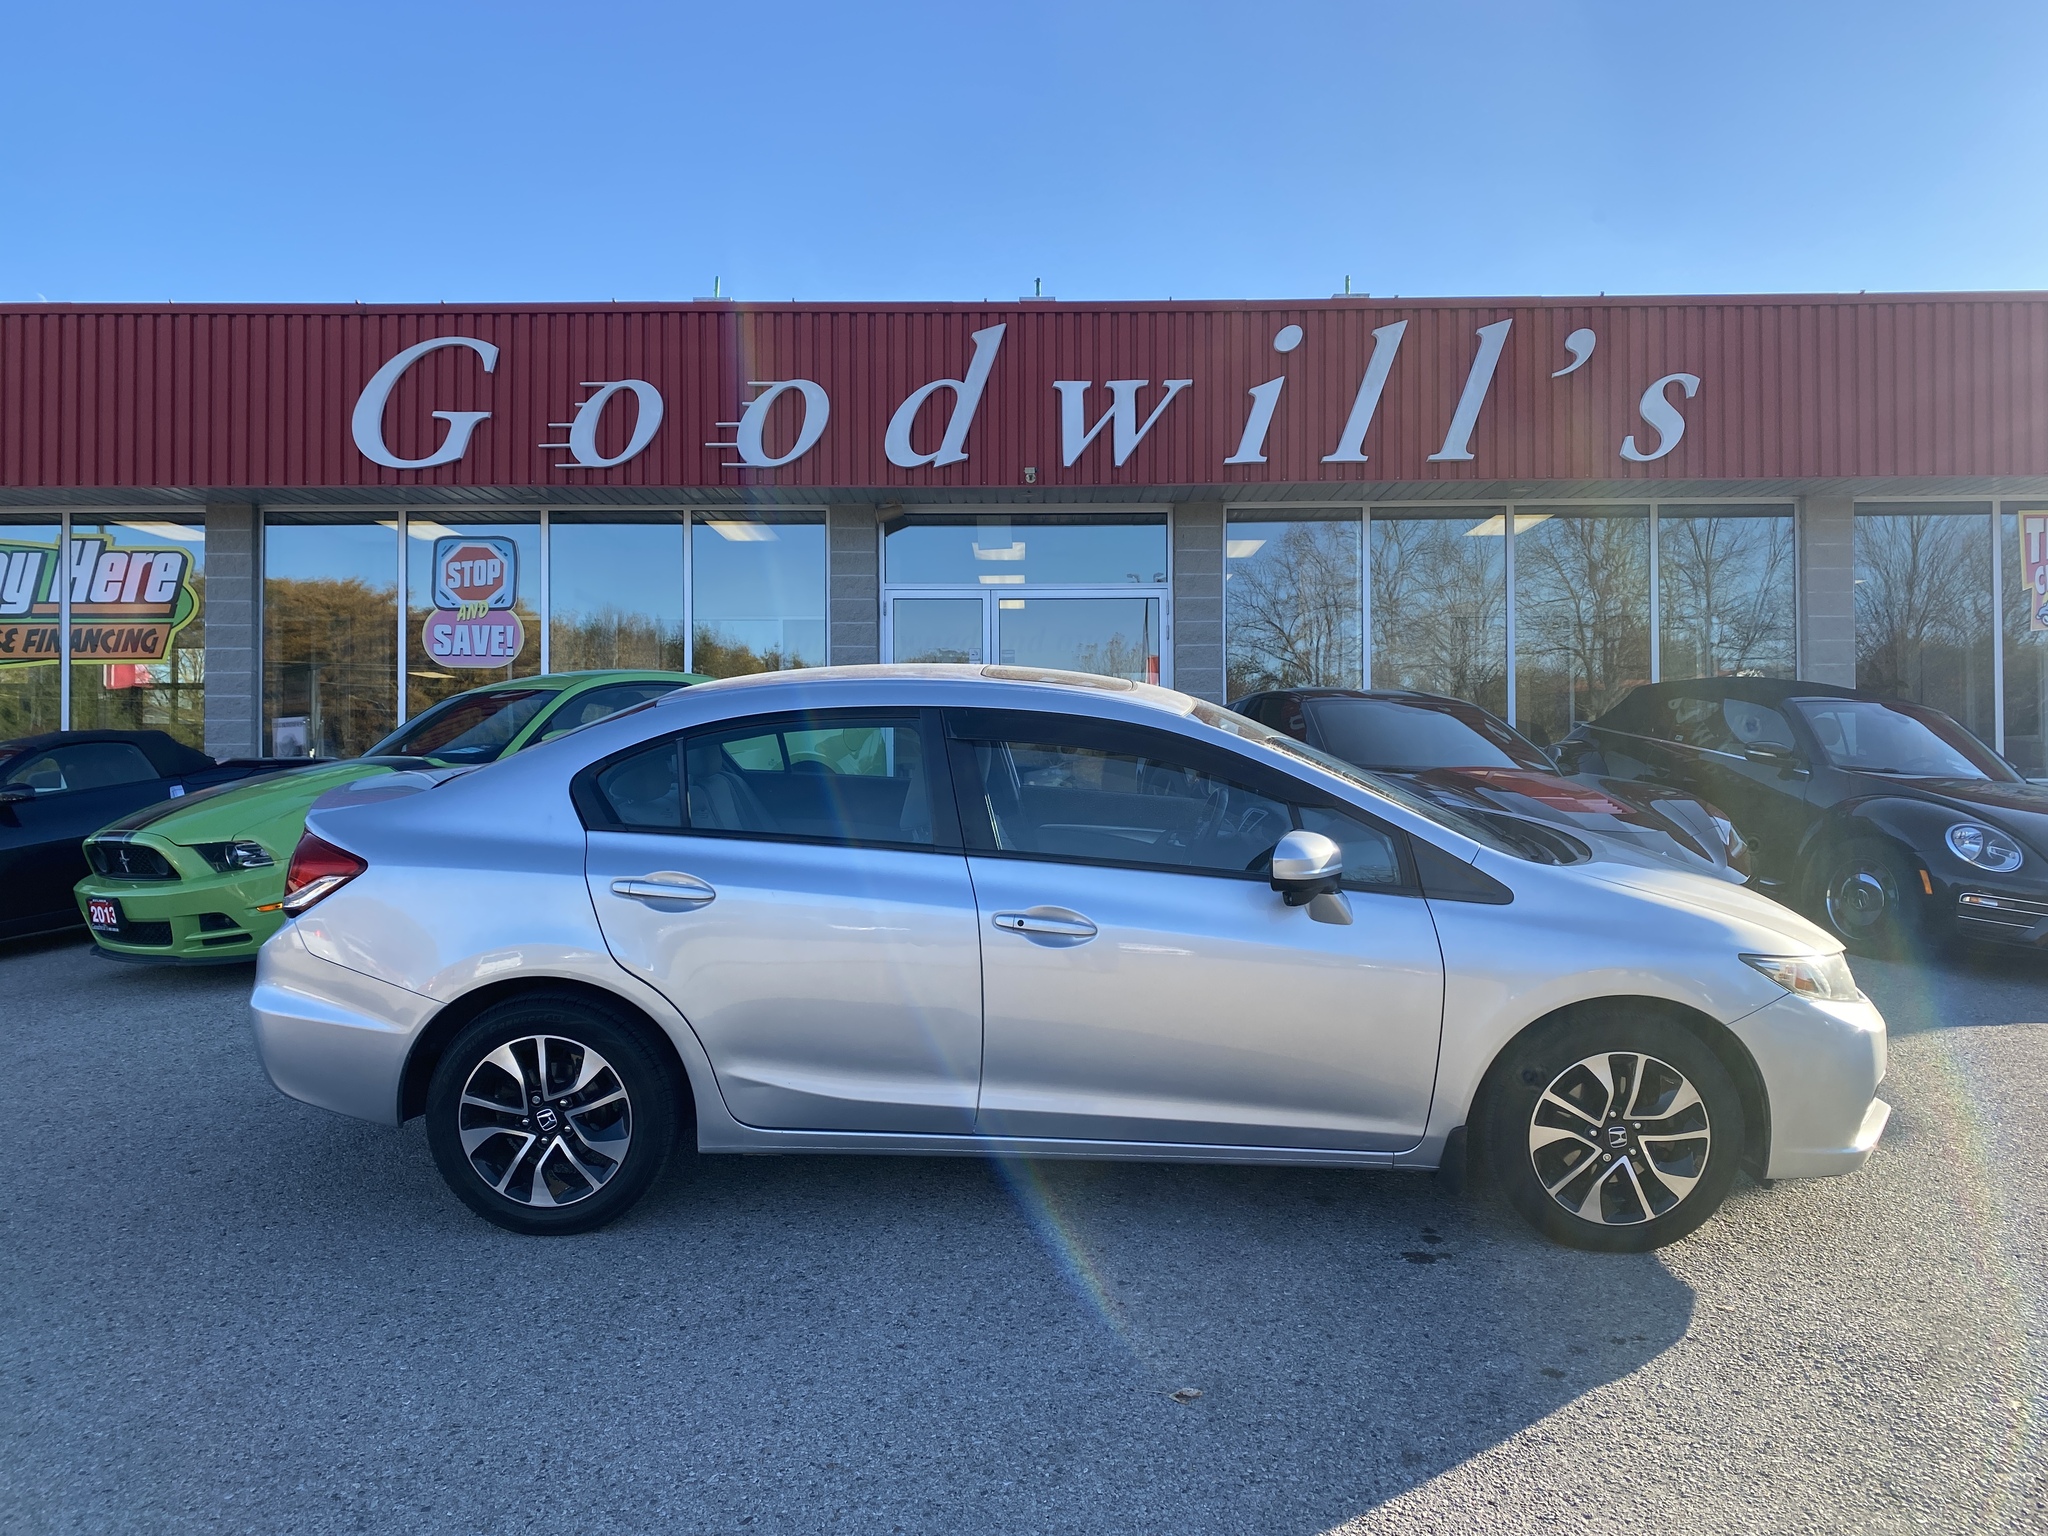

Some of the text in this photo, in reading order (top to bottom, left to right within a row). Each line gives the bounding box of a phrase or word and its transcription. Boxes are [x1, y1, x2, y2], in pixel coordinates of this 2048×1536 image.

[350, 318, 1702, 469] Goodwill's
[0, 540, 182, 614] y Here
[447, 558, 501, 589] STOP
[457, 600, 490, 622] AND
[22, 627, 159, 653] FINANCING
[433, 624, 515, 657] SAVE!
[90, 906, 117, 924] 2013
